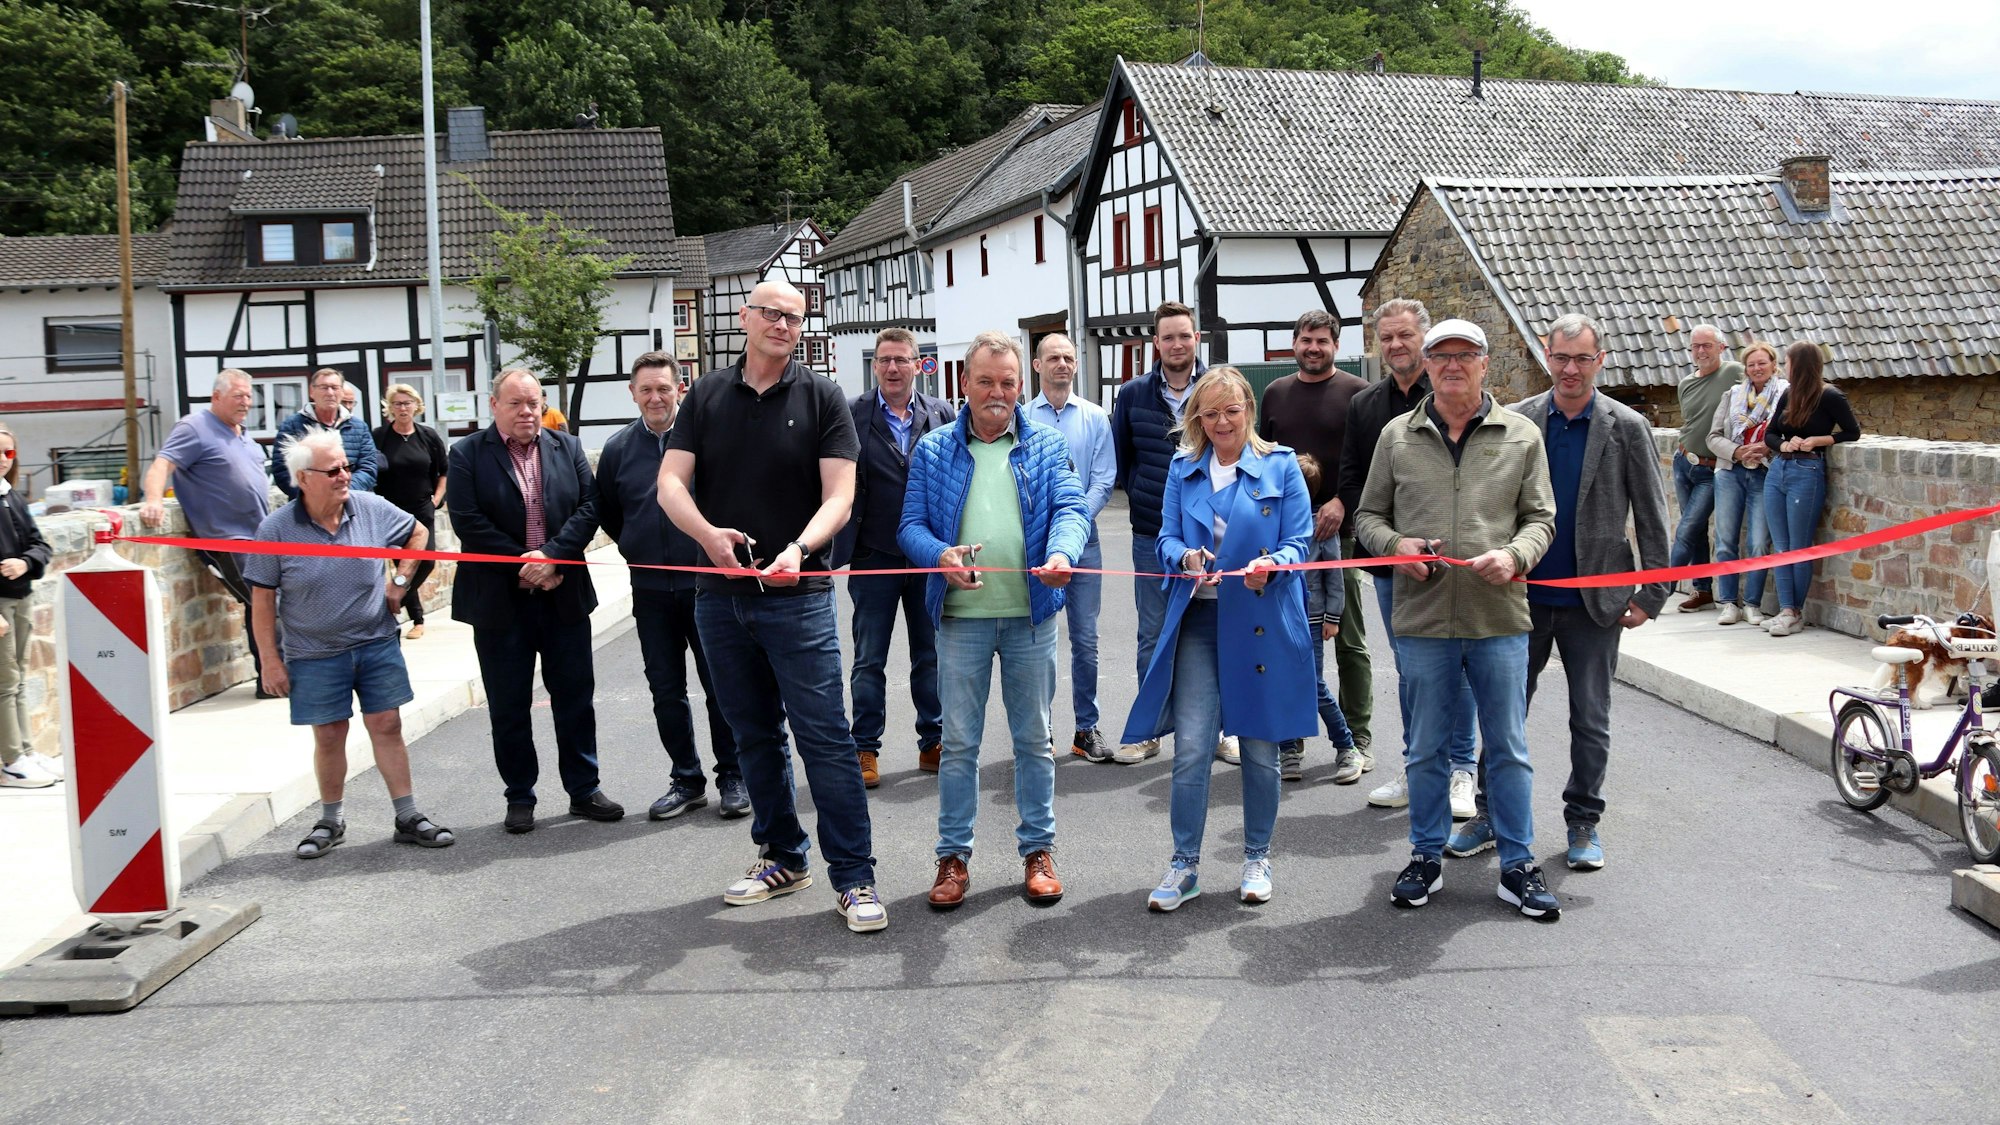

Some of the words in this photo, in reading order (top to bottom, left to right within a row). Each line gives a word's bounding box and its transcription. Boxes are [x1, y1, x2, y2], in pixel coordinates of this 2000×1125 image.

[1961, 643, 1993, 652] PUKY
[97, 650, 116, 658] AVS
[1903, 705, 1911, 733] PUKY
[109, 828, 127, 837] AVS
